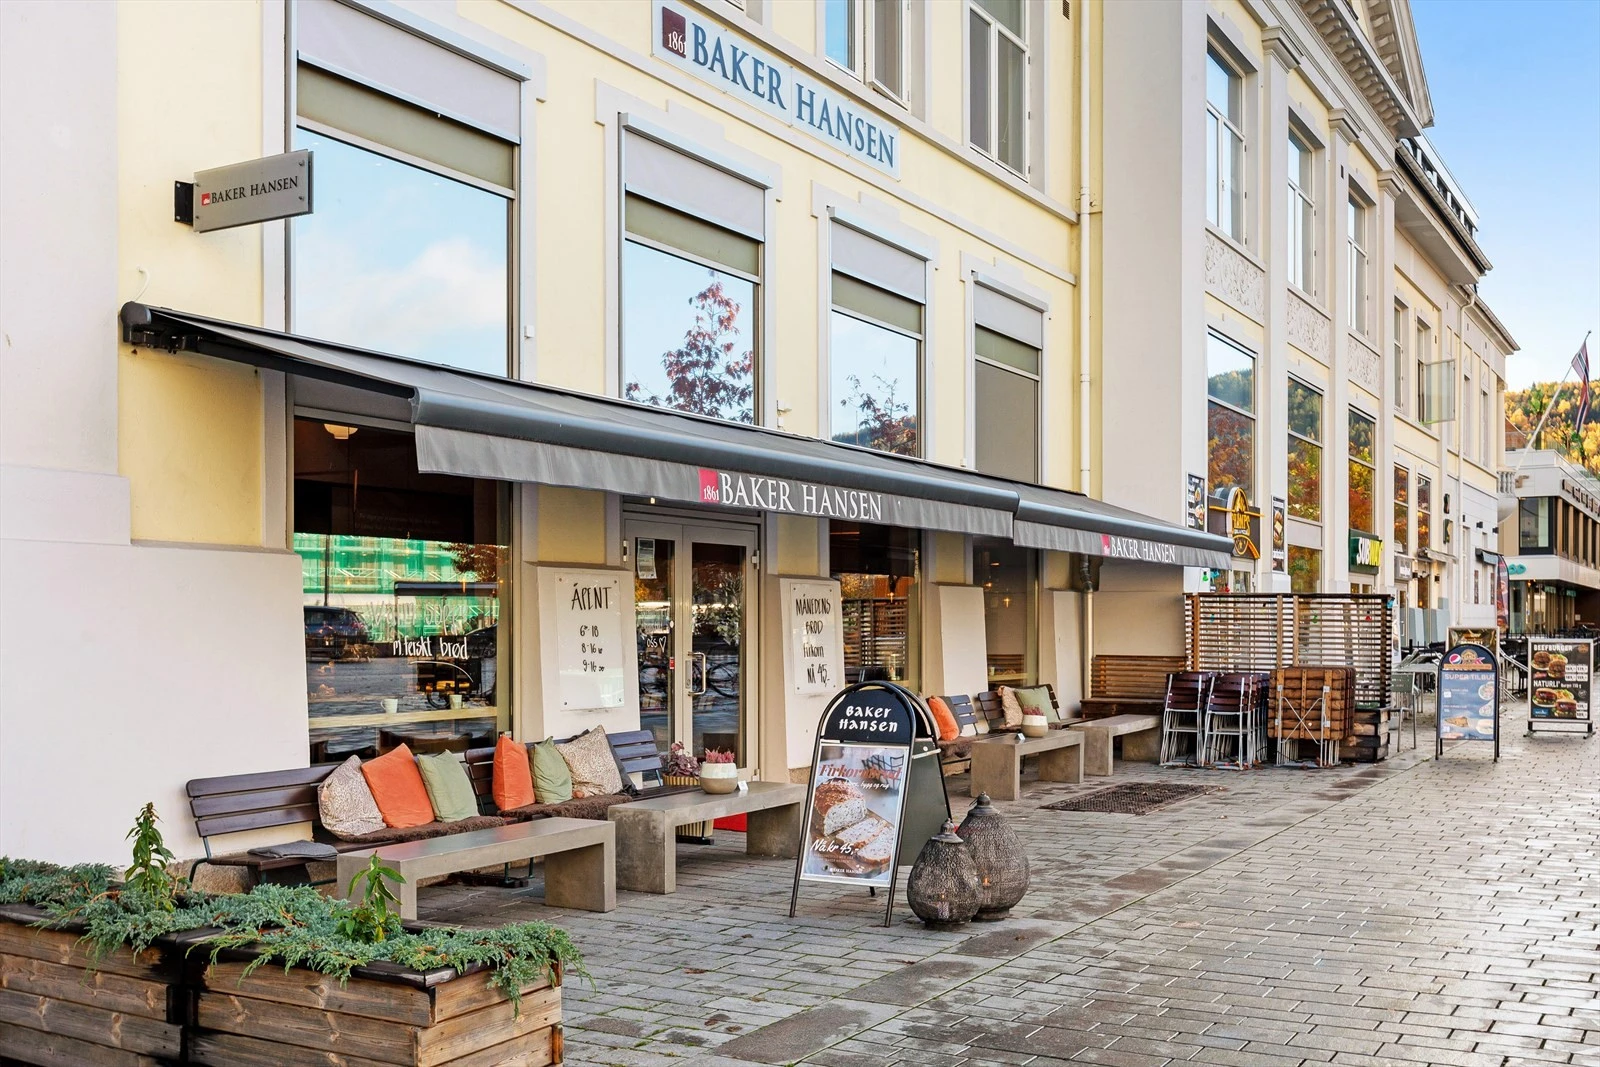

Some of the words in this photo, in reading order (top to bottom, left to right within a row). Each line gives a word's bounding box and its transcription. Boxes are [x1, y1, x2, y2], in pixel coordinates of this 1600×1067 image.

[692, 22, 787, 110] BAKER
[796, 82, 894, 168] HANSEN
[211, 187, 246, 204] BAKER
[250, 175, 299, 197] HANSEN
[703, 484, 720, 502] 1861
[720, 472, 796, 512] BAKER
[802, 483, 882, 521] HANSEN
[1111, 536, 1142, 559] BAKER
[1142, 541, 1176, 563] HANSEN
[440, 636, 469, 660] brød
